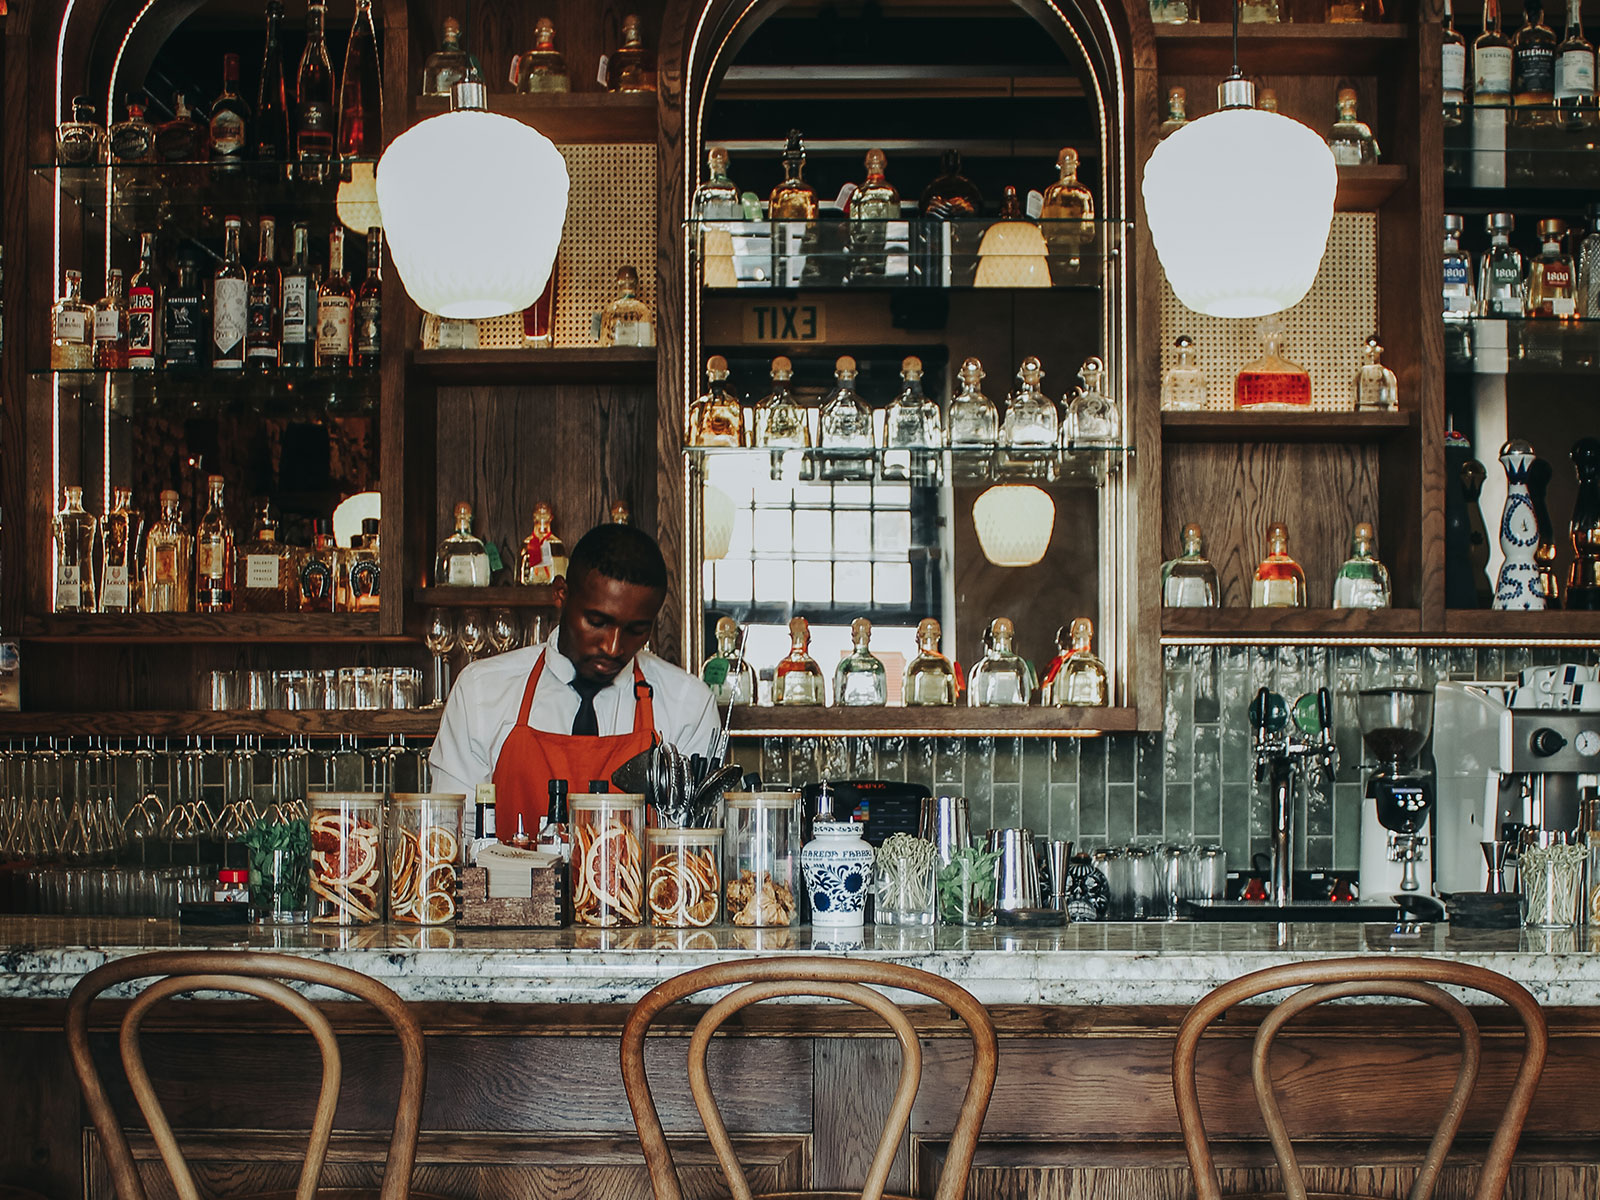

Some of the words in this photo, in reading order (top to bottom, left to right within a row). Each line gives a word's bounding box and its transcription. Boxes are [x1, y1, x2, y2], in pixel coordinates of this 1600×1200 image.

[1443, 267, 1466, 278] 1800
[1495, 267, 1518, 278] 1800
[1546, 271, 1569, 281] 1800
[322, 300, 349, 308] BUSCA
